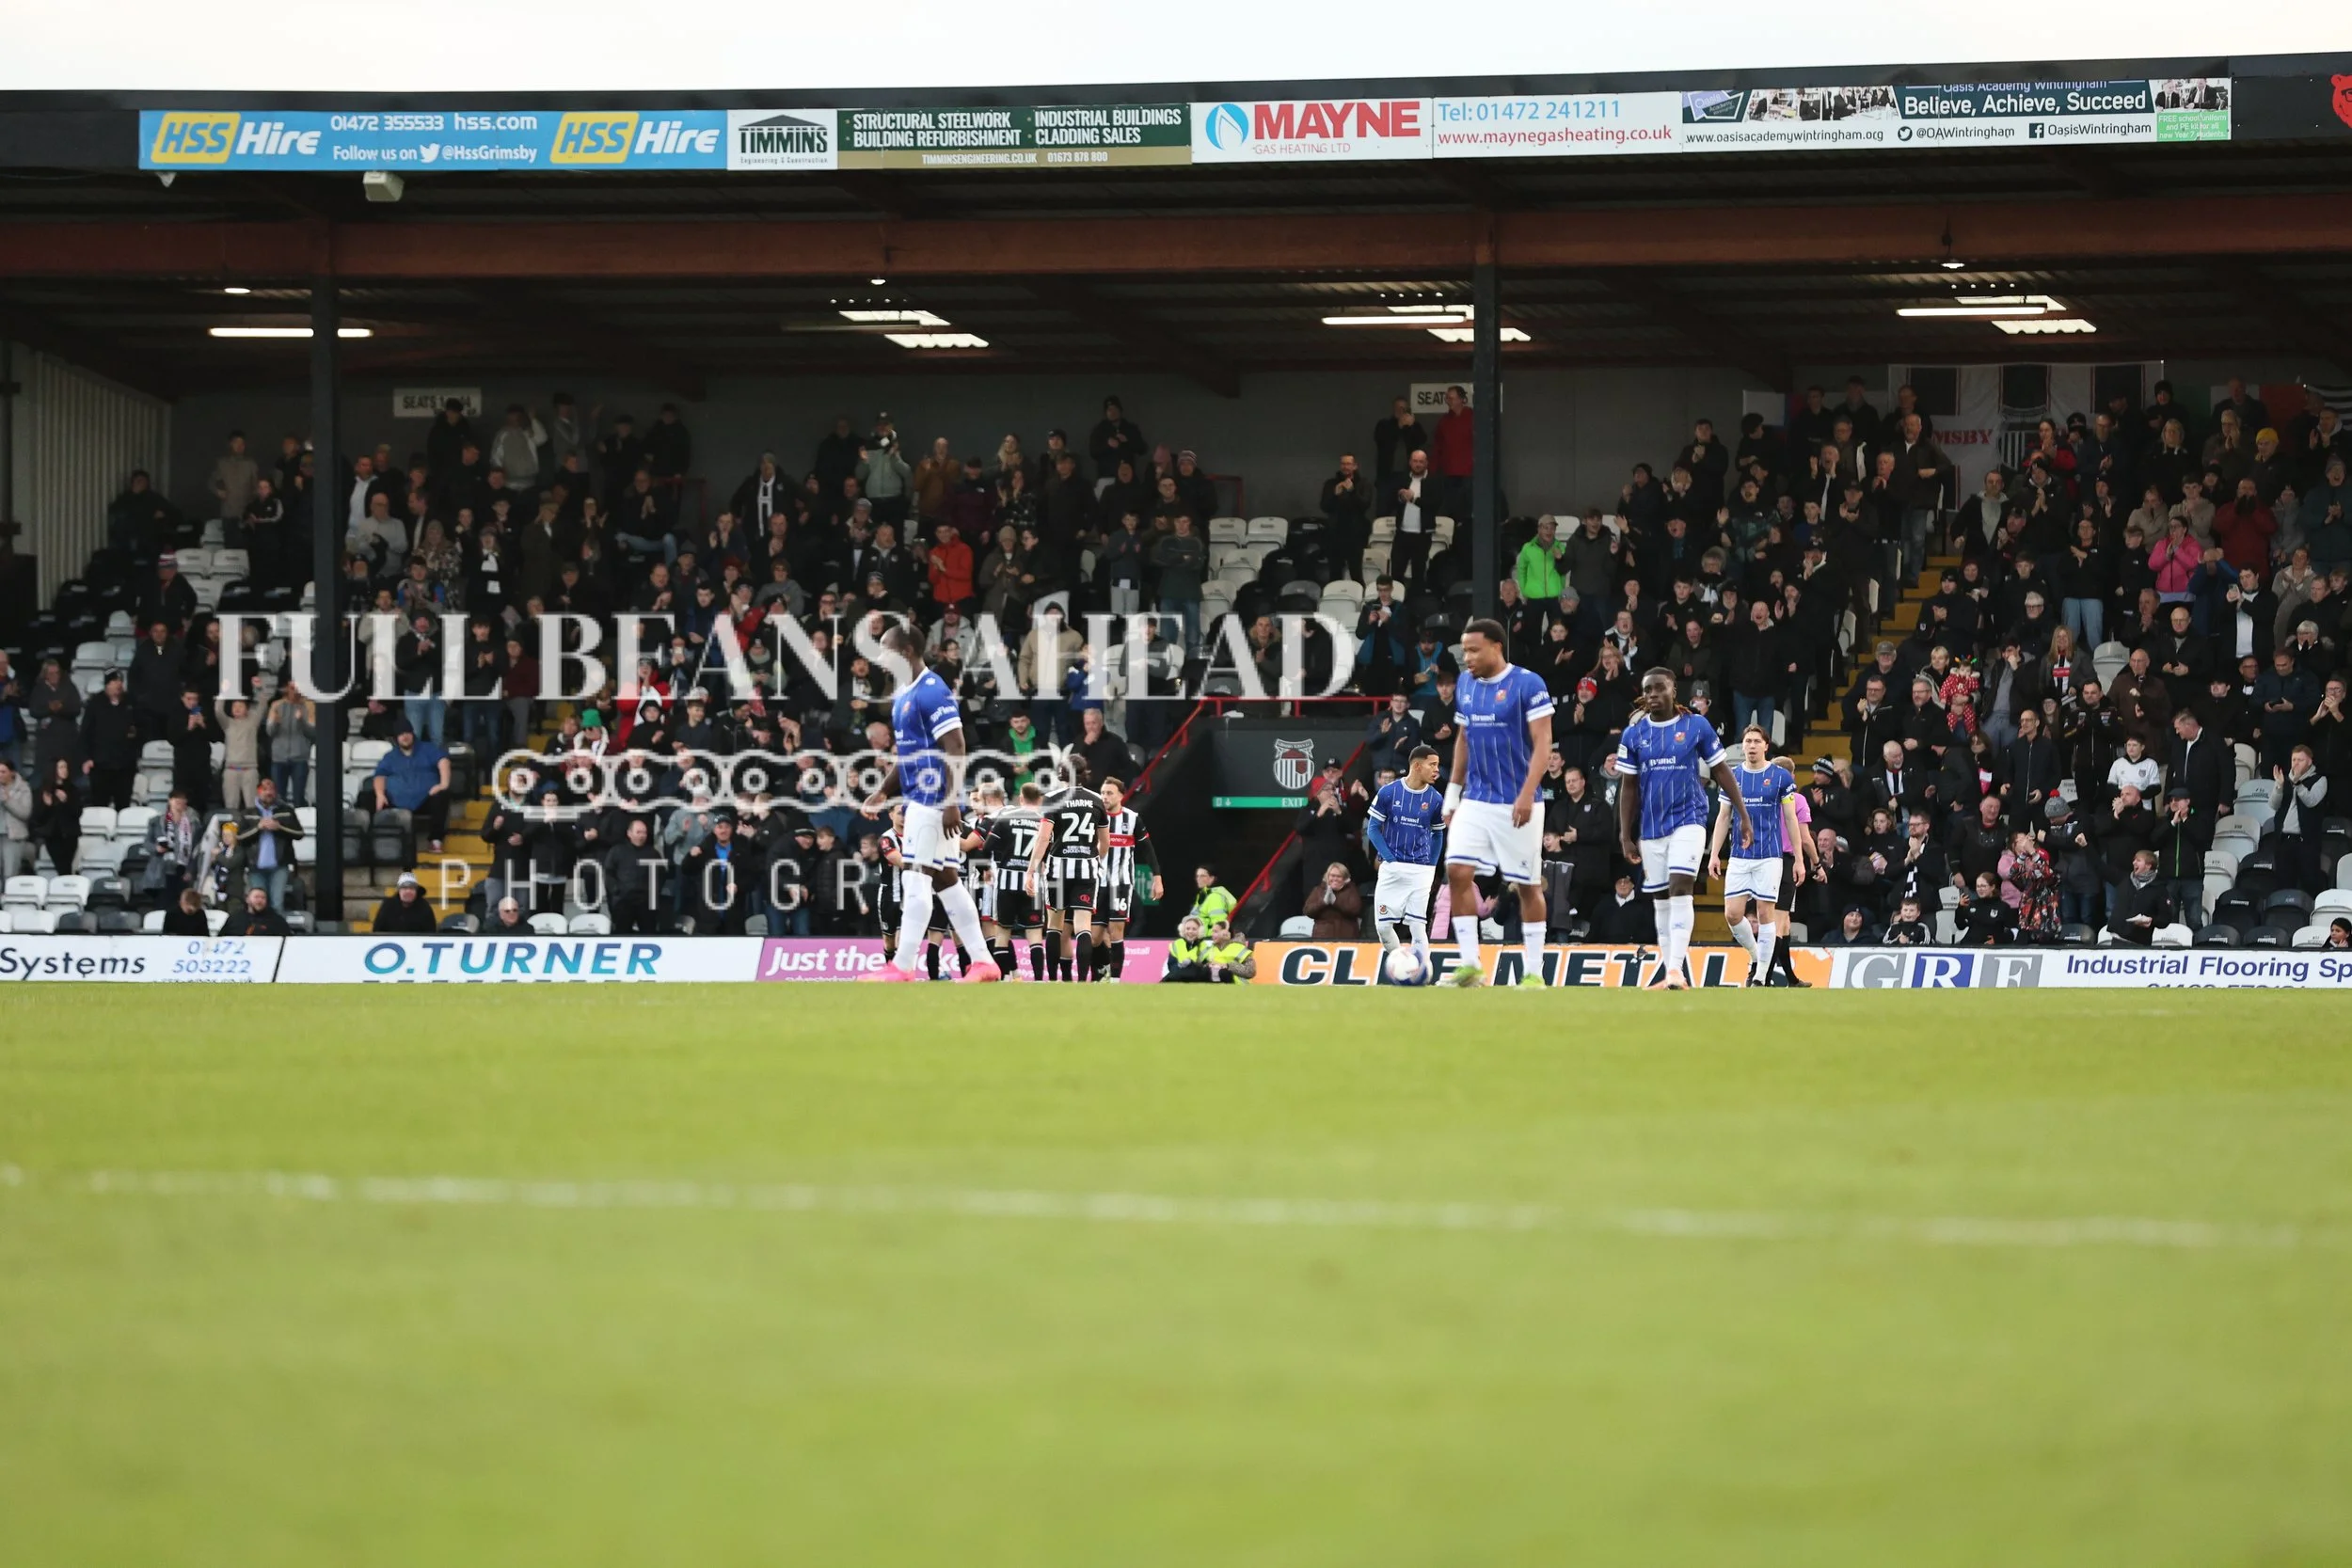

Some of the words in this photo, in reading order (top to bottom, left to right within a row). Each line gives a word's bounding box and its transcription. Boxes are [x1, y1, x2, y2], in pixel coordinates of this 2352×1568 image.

[1546, 100, 1620, 118] 241211
[1904, 96, 1977, 117] Believe,
[1982, 93, 2060, 115] Achieve,
[2067, 90, 2146, 111] Succeed
[331, 115, 379, 129] 01472
[384, 115, 443, 130] 355533
[454, 113, 537, 130] hss.com
[853, 112, 934, 130] STRUCTURAL
[938, 110, 1011, 129] STEELWORK
[1035, 110, 1110, 128] INDUSTRIAL
[1113, 108, 1182, 125] BUILDINGS
[1254, 101, 1421, 140] MAYNE
[161, 122, 230, 153] HSS
[235, 121, 322, 154] Hire
[559, 122, 628, 153] HSS
[634, 121, 720, 154] Hire
[853, 130, 913, 148] BUILDING
[917, 128, 1023, 147] REFURBISHMENT
[1036, 129, 1100, 146] CLADDING
[1103, 127, 1141, 144] SALES
[1438, 125, 1672, 147] www.maynegasheating.co.uk
[1687, 128, 1883, 145] www.oasisacademywintringham.org
[1916, 124, 2015, 139] @OAWintringham
[2048, 122, 2152, 137] OasisWintringham
[739, 128, 829, 154] TIMMINS
[1255, 144, 1277, 155] GAS
[1280, 143, 1328, 154] HEATING
[1331, 142, 1352, 153] LTD
[333, 145, 377, 160] Follow
[382, 149, 396, 160] us
[400, 149, 417, 160] on
[441, 145, 537, 163] @HssGrimsby
[1047, 152, 1073, 164] 01673
[1418, 390, 1447, 405] SEAT
[1065, 799, 1094, 809] THARME
[1281, 798, 1303, 808] EXIT
[1061, 812, 1096, 843] 24
[1011, 828, 1039, 858] 17
[1115, 897, 1128, 911] 16
[0, 947, 146, 981] Systems
[173, 959, 251, 974] 503222
[365, 942, 663, 976] O.TURNER
[765, 946, 829, 976] Just
[834, 945, 885, 973] the
[2067, 955, 2195, 977] Industrial
[2201, 957, 2309, 982] Flooring
